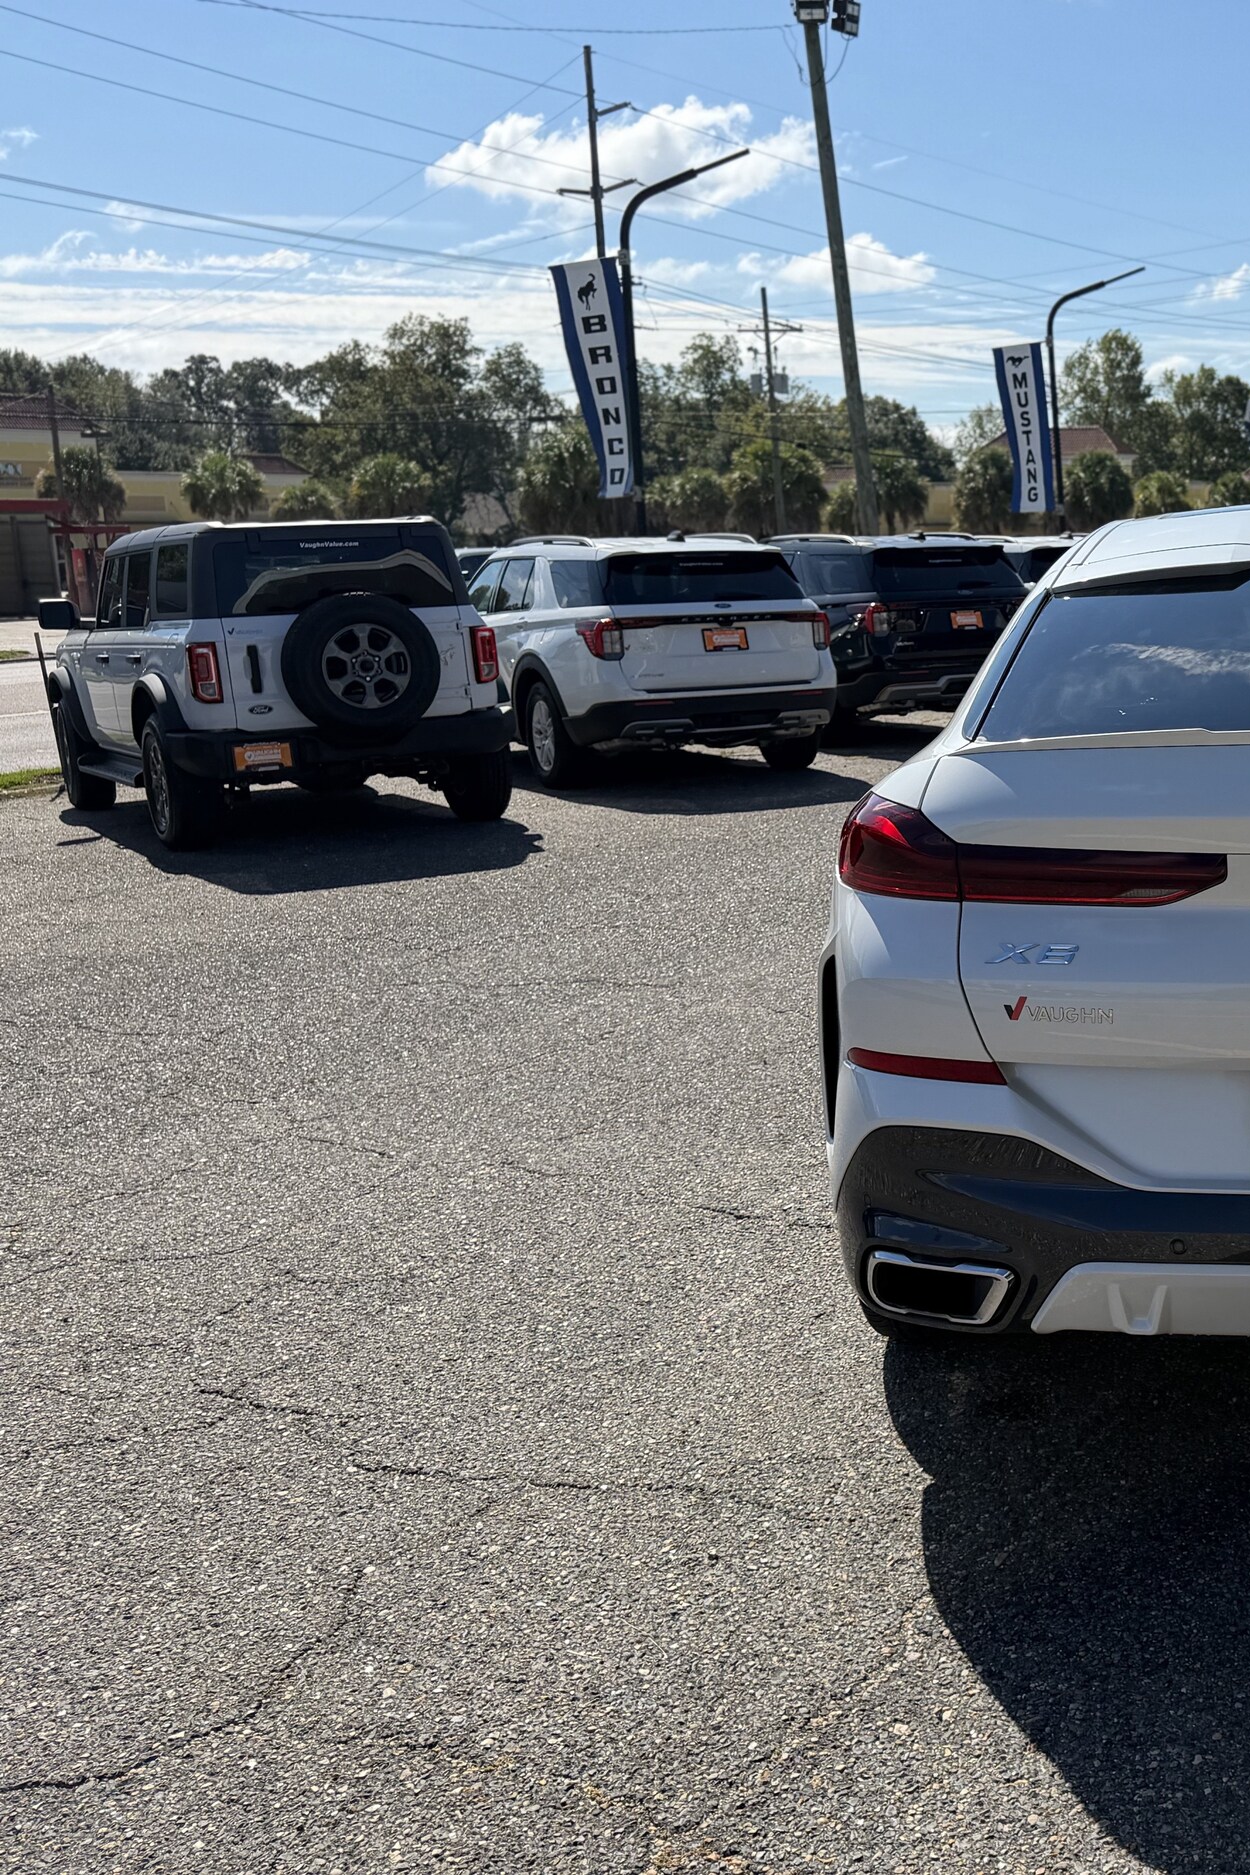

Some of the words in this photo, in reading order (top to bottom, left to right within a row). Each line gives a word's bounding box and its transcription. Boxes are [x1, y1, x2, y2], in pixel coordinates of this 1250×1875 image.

[581, 314, 625, 485] BRONCO
[1012, 372, 1039, 503] MUSTANG
[984, 943, 1079, 965] X6
[1026, 1005, 1114, 1024] VAUGHN
